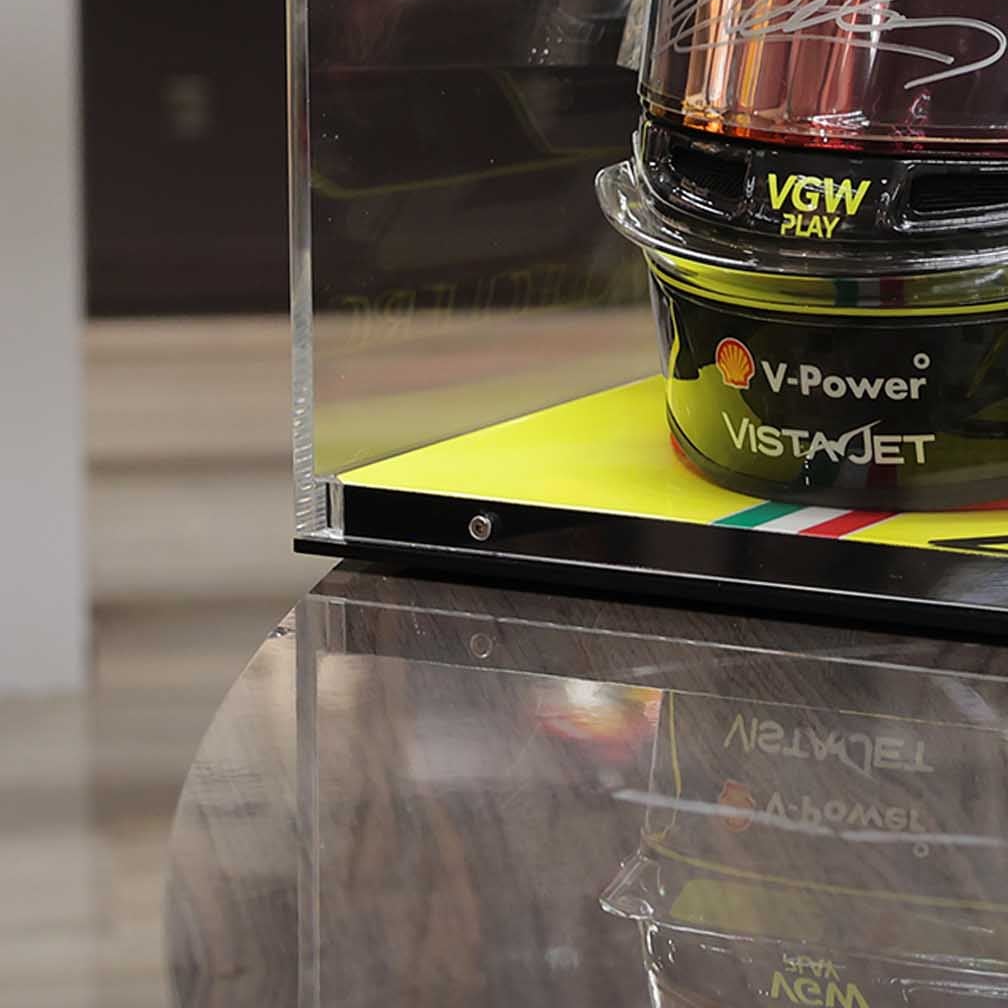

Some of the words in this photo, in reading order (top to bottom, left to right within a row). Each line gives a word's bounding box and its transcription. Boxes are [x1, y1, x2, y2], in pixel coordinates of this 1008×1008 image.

[768, 173, 872, 215] VGW
[781, 213, 840, 239] PLAY
[761, 360, 927, 400] V-Power
[722, 411, 936, 465] VISTAJET
